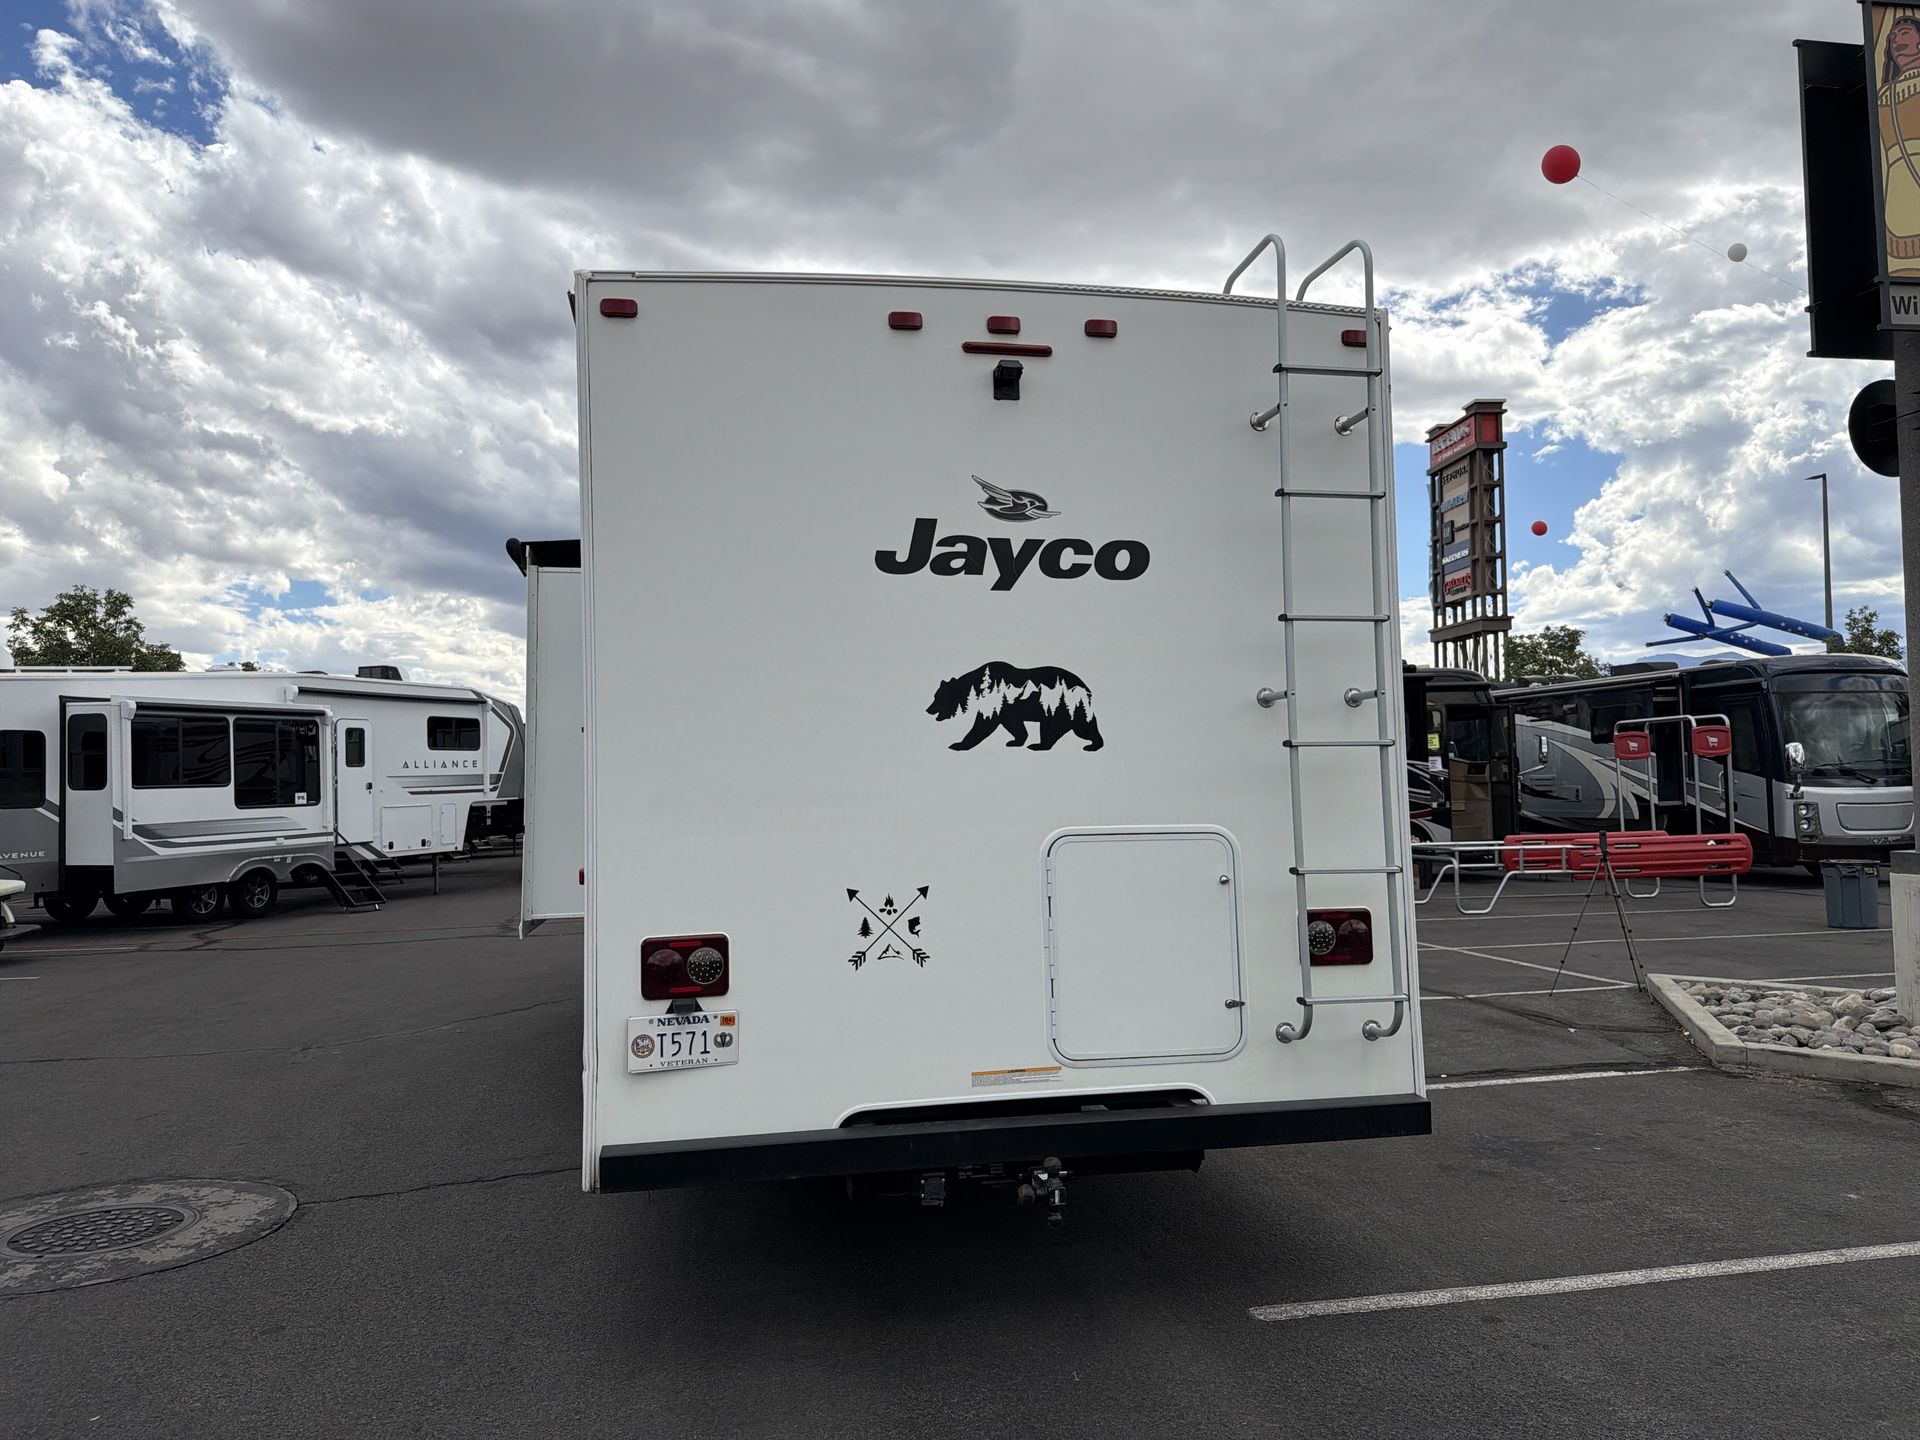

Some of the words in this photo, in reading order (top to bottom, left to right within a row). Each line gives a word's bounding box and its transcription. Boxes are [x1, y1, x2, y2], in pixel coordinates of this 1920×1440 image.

[874, 517, 1151, 591] Jayco
[402, 759, 478, 769] ALLIANCE
[657, 1014, 711, 1027] NEVADA
[656, 1030, 711, 1058] T571
[660, 1057, 708, 1068] VETERAN
